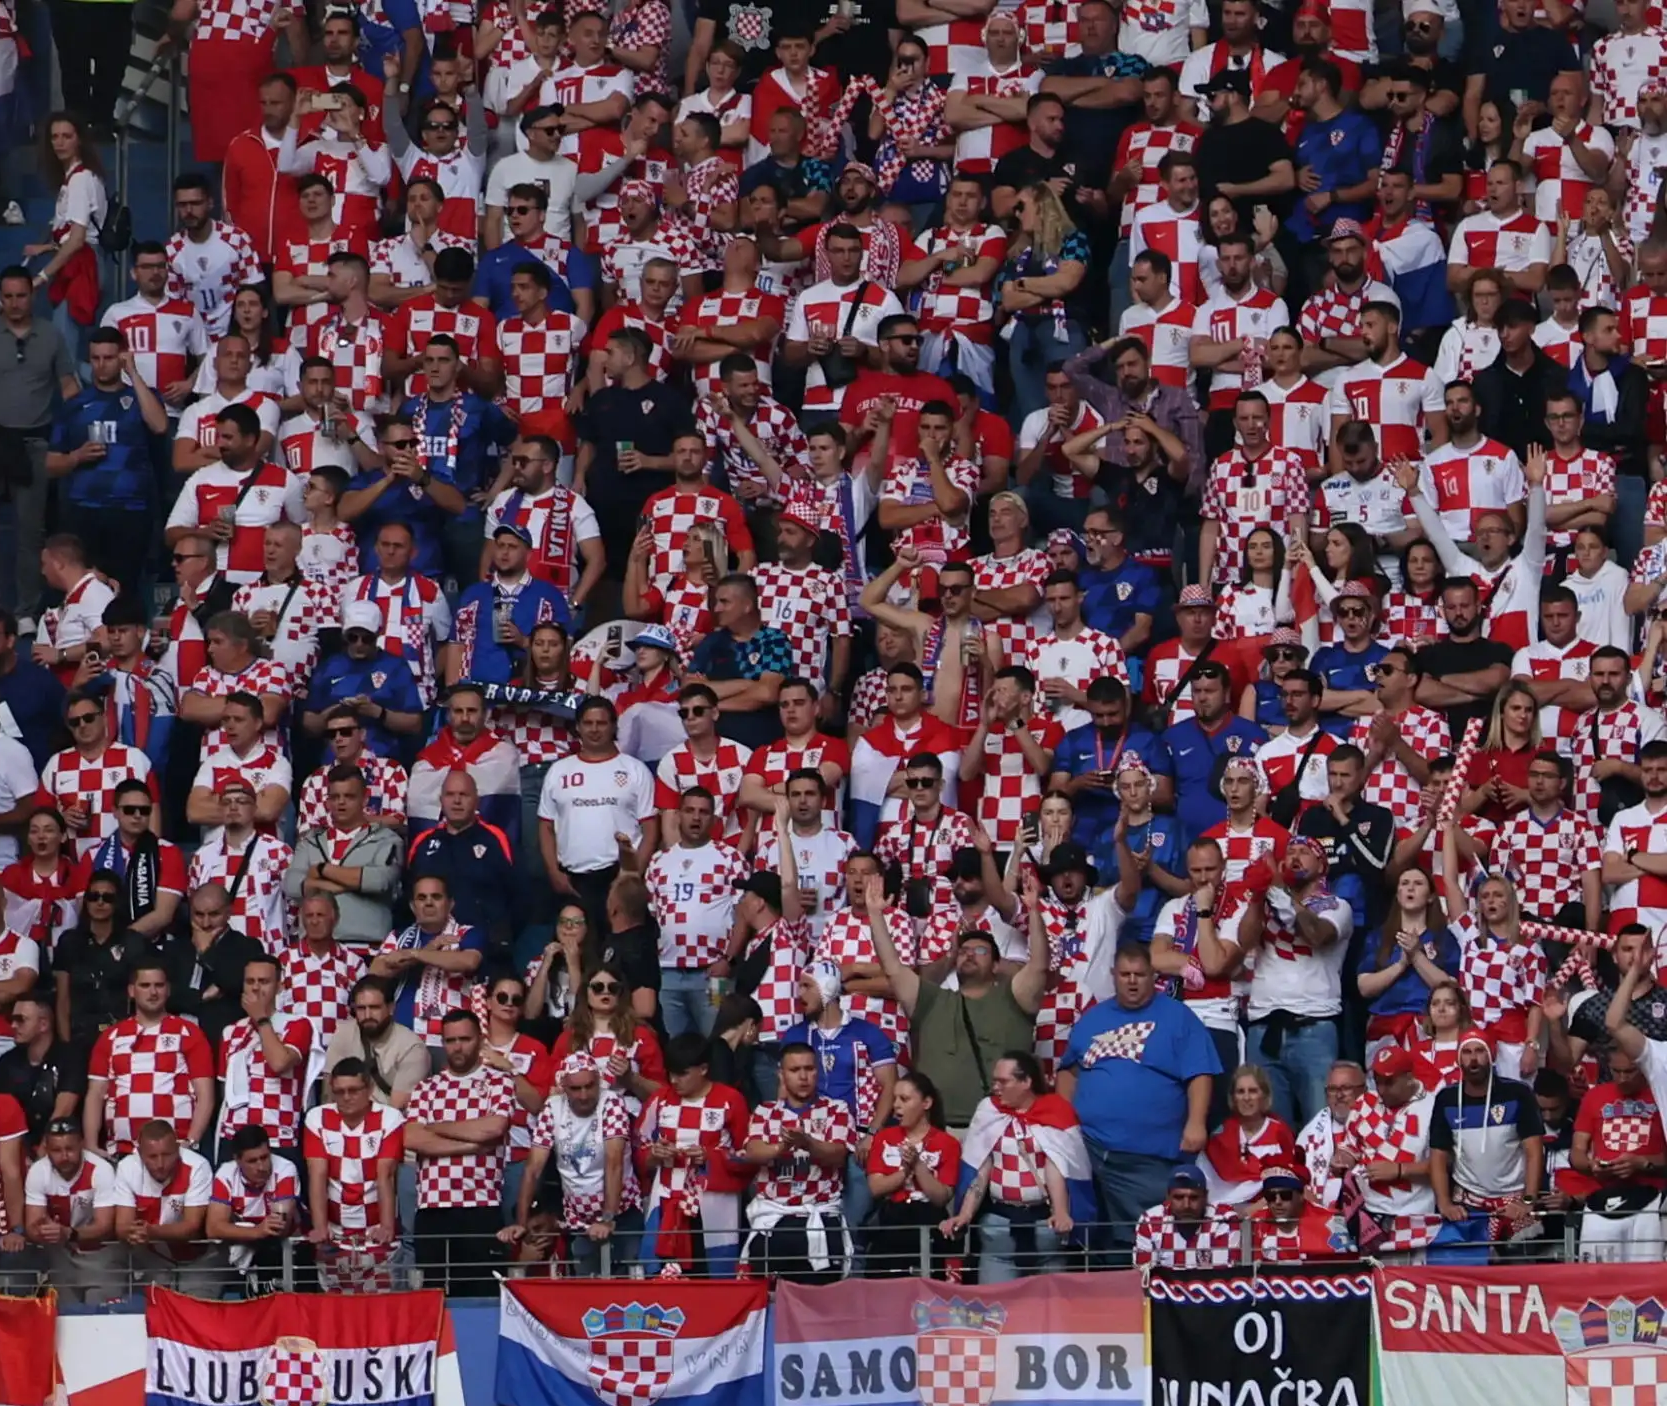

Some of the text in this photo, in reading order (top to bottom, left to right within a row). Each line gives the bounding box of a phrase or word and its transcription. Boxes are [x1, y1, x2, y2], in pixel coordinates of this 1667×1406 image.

[201, 290, 217, 310] 11
[128, 327, 149, 351] 10
[287, 447, 300, 469] 10
[1241, 494, 1260, 512] 10
[1359, 505, 1368, 522] 5
[774, 600, 792, 619] 16
[562, 772, 584, 789] 10
[673, 883, 694, 901] 19
[824, 963, 837, 977] 11
[1383, 1280, 1551, 1334] SANTA
[1234, 1312, 1284, 1360] OJ
